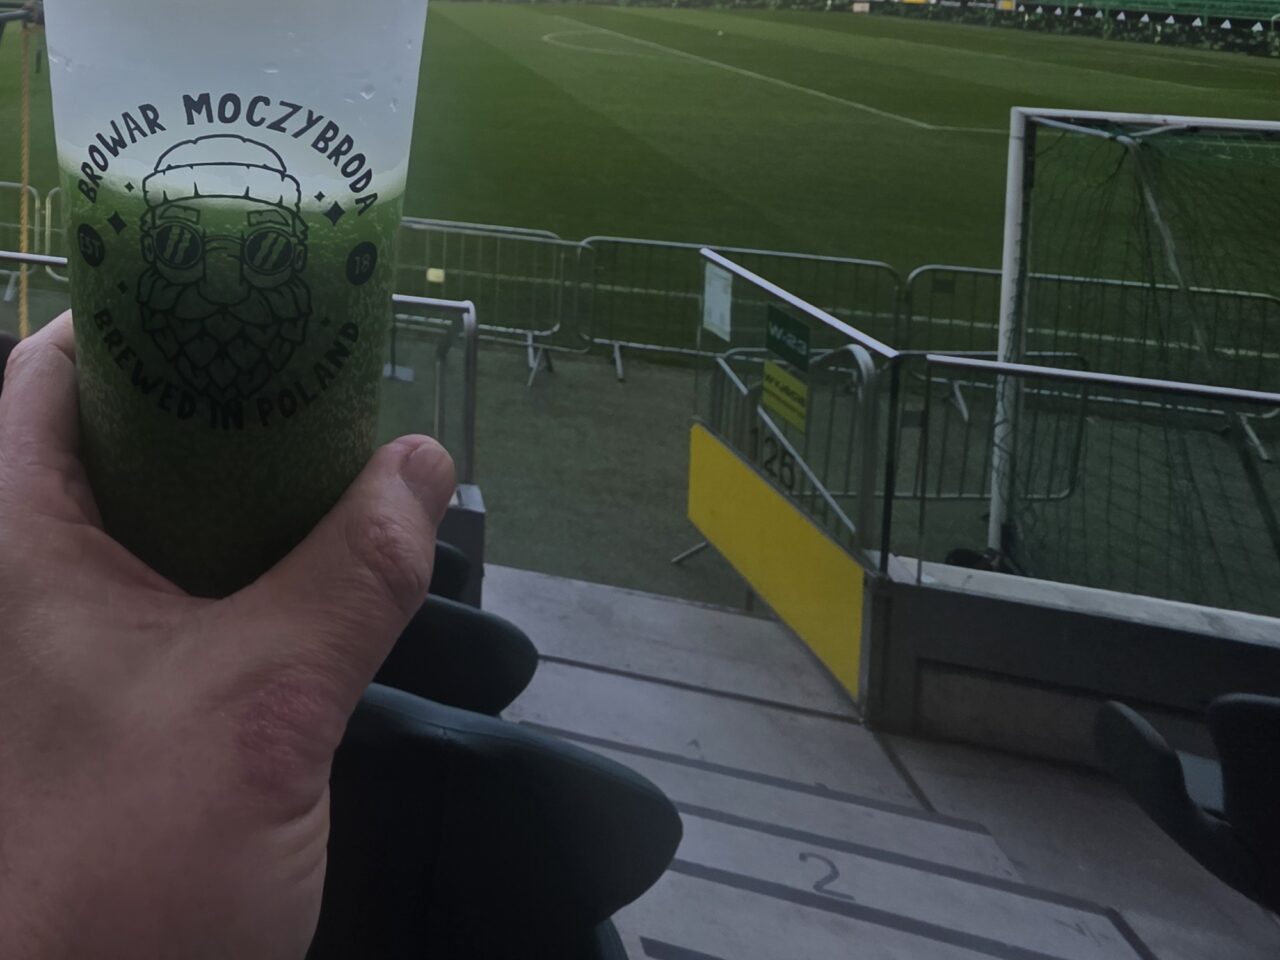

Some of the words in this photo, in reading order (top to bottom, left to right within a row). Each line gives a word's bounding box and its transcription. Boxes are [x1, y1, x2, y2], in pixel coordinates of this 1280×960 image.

[78, 103, 166, 204] BROWAR
[182, 92, 378, 216] MOCZYBRODA
[93, 308, 197, 420] BREWED
[209, 398, 245, 431] IN
[256, 322, 360, 428] POLAND
[799, 851, 857, 902] 2
